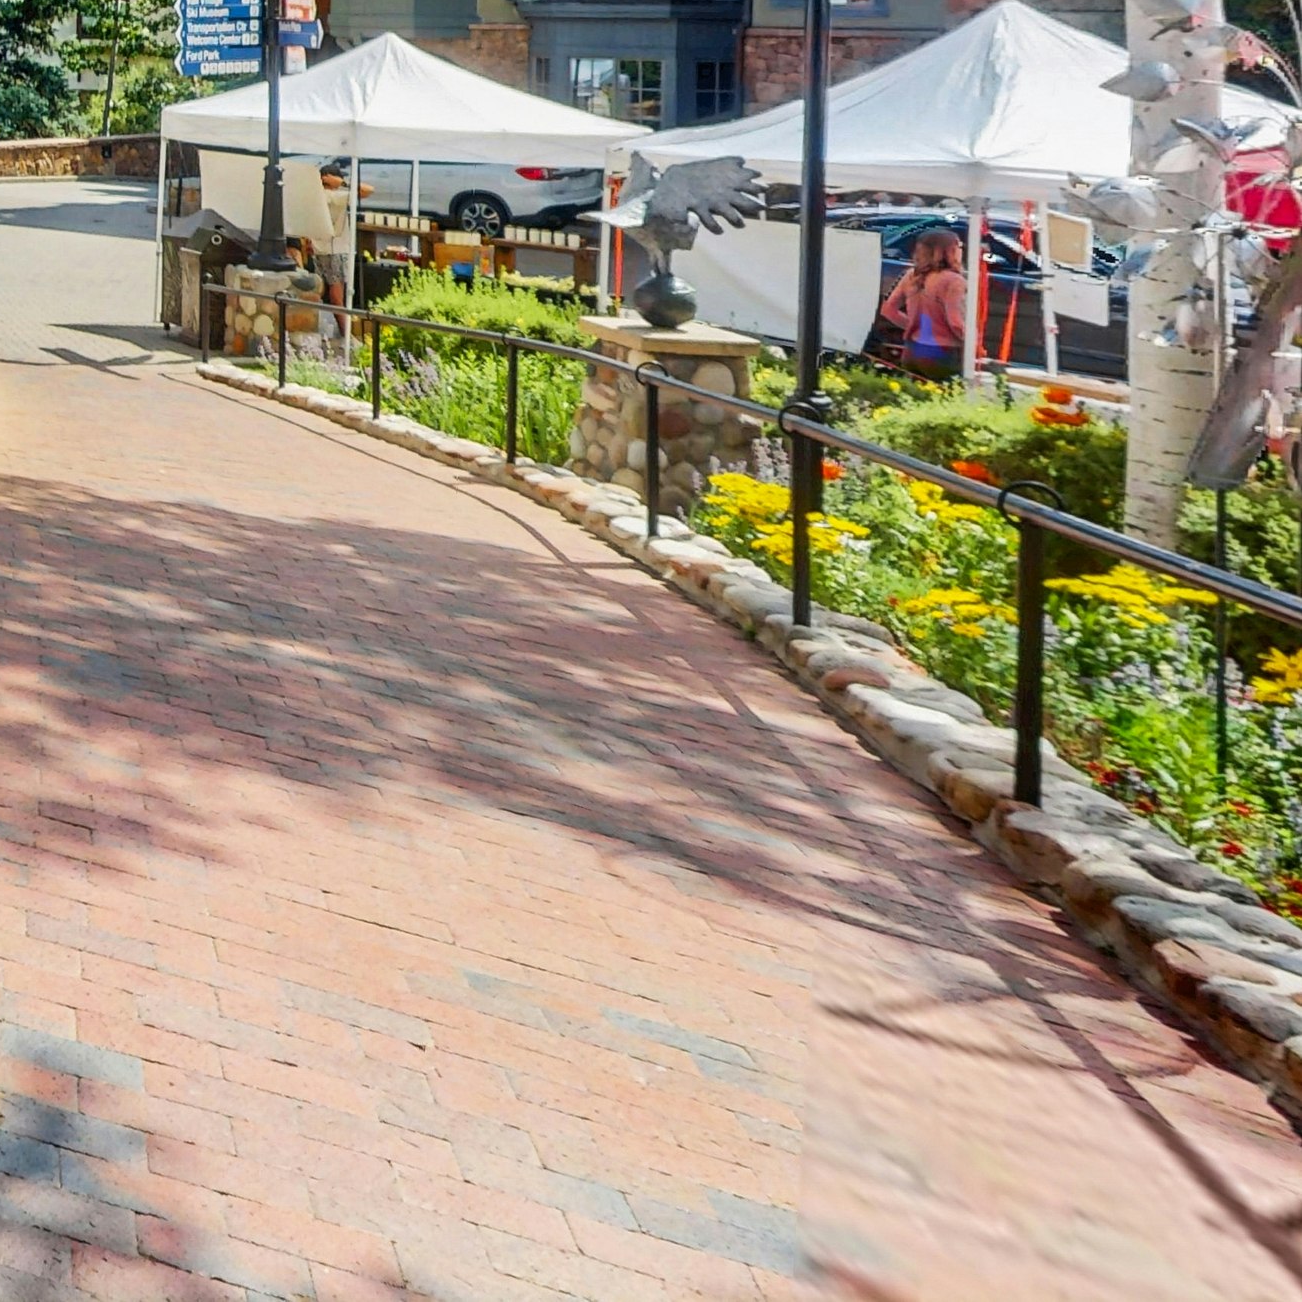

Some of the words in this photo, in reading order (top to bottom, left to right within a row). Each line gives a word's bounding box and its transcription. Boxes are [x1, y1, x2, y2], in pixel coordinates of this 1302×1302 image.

[186, 7, 198, 18] Ski
[199, 8, 229, 18] Museum
[187, 22, 236, 34] Transportation
[187, 35, 218, 46] Welcome
[219, 35, 242, 45] Center
[185, 50, 202, 61] Ford
[203, 50, 220, 61] Park
